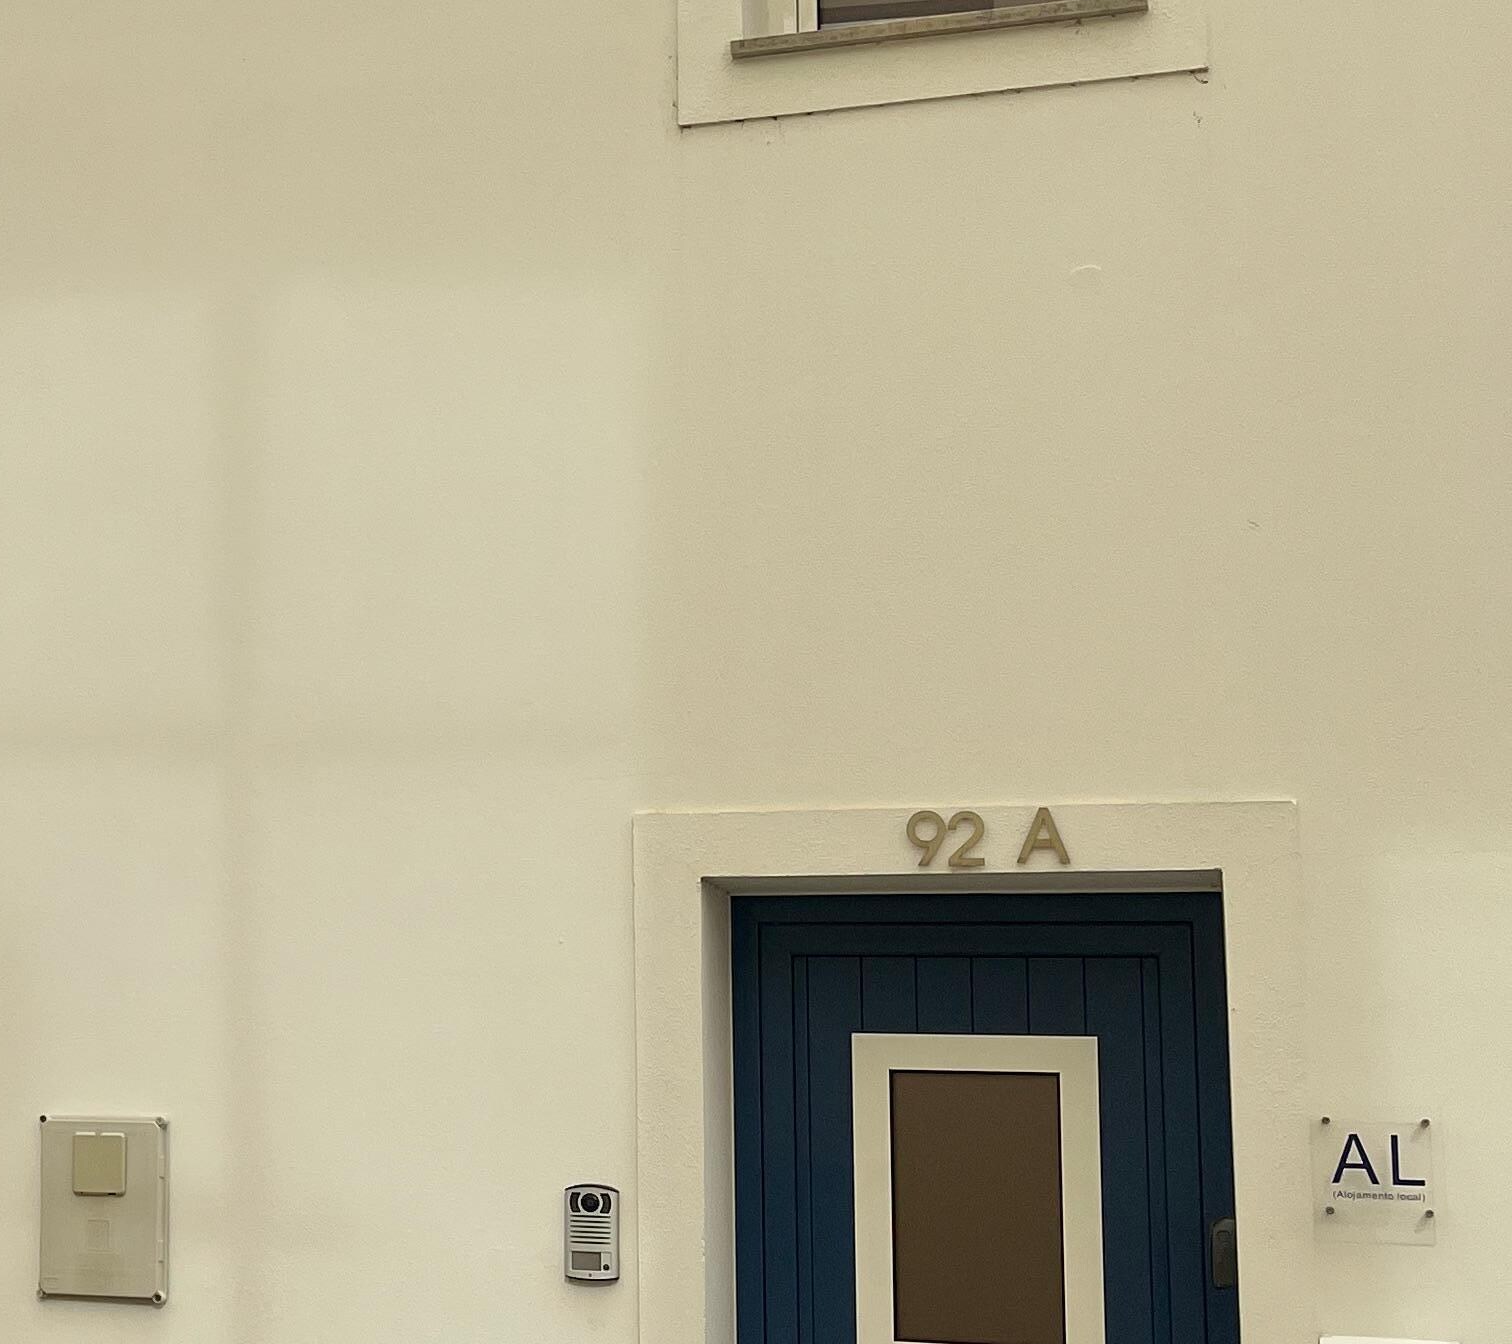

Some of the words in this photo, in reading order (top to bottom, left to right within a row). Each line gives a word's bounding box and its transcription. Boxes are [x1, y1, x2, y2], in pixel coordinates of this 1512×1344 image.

[906, 810, 986, 867] 92
[1016, 806, 1071, 865] A
[1331, 1133, 1426, 1187] AL
[1332, 1190, 1394, 1201] (Alojamento
[1396, 1193, 1426, 1203] local)
